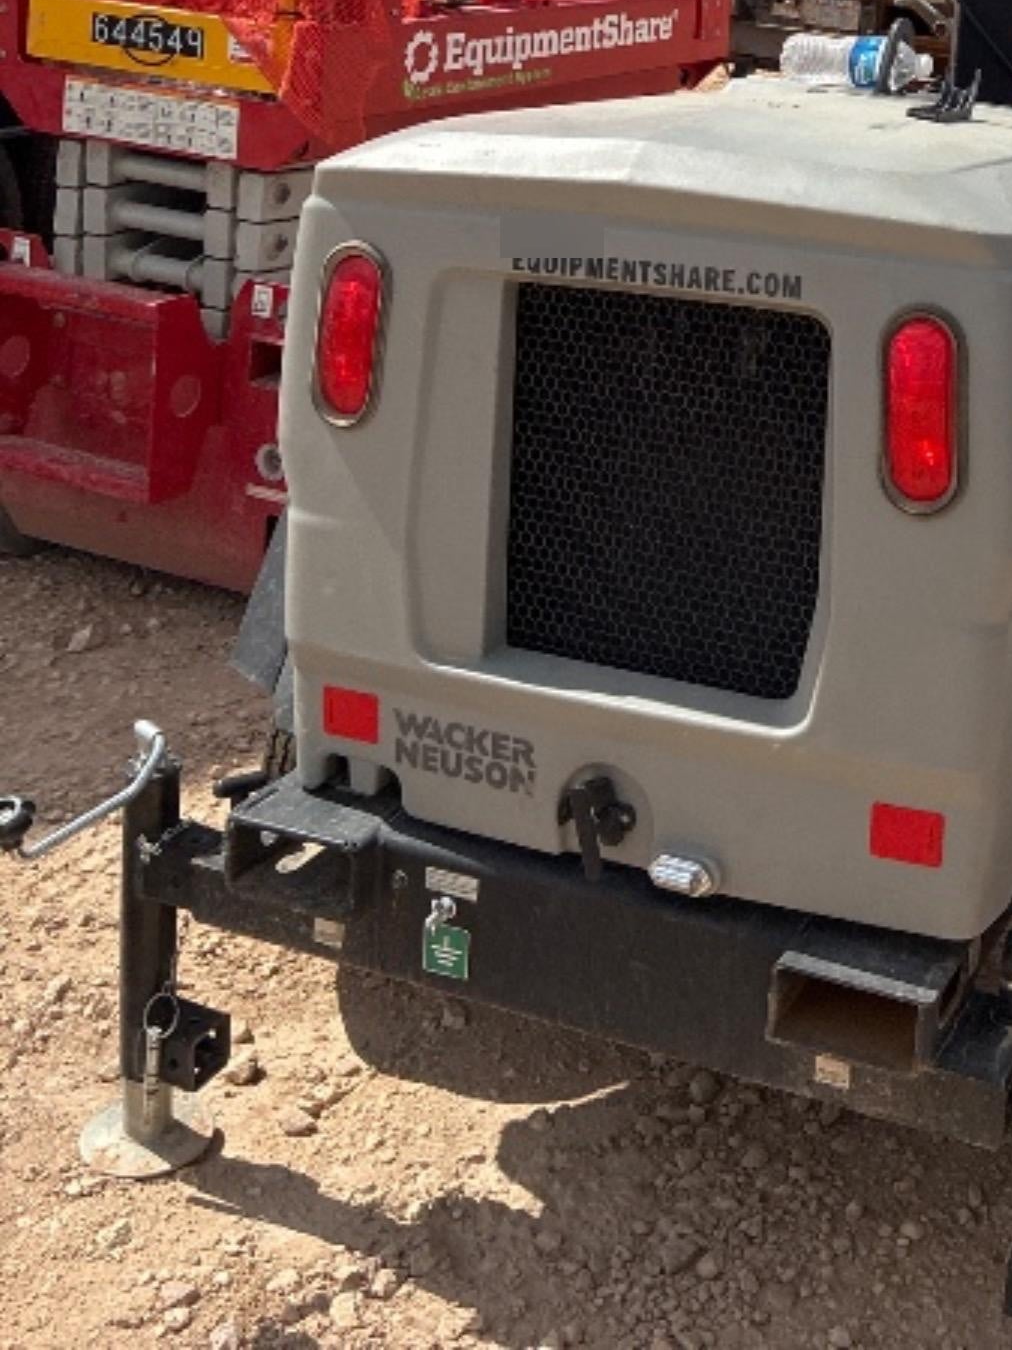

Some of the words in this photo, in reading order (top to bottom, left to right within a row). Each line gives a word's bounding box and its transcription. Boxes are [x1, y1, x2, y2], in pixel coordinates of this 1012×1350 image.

[94, 13, 203, 60] 644549
[444, 12, 674, 77] EquipmentShare
[512, 257, 802, 299] EQUIPMENTSHARE.COM
[392, 706, 537, 769] WACKER
[394, 737, 537, 798] NEUSON
